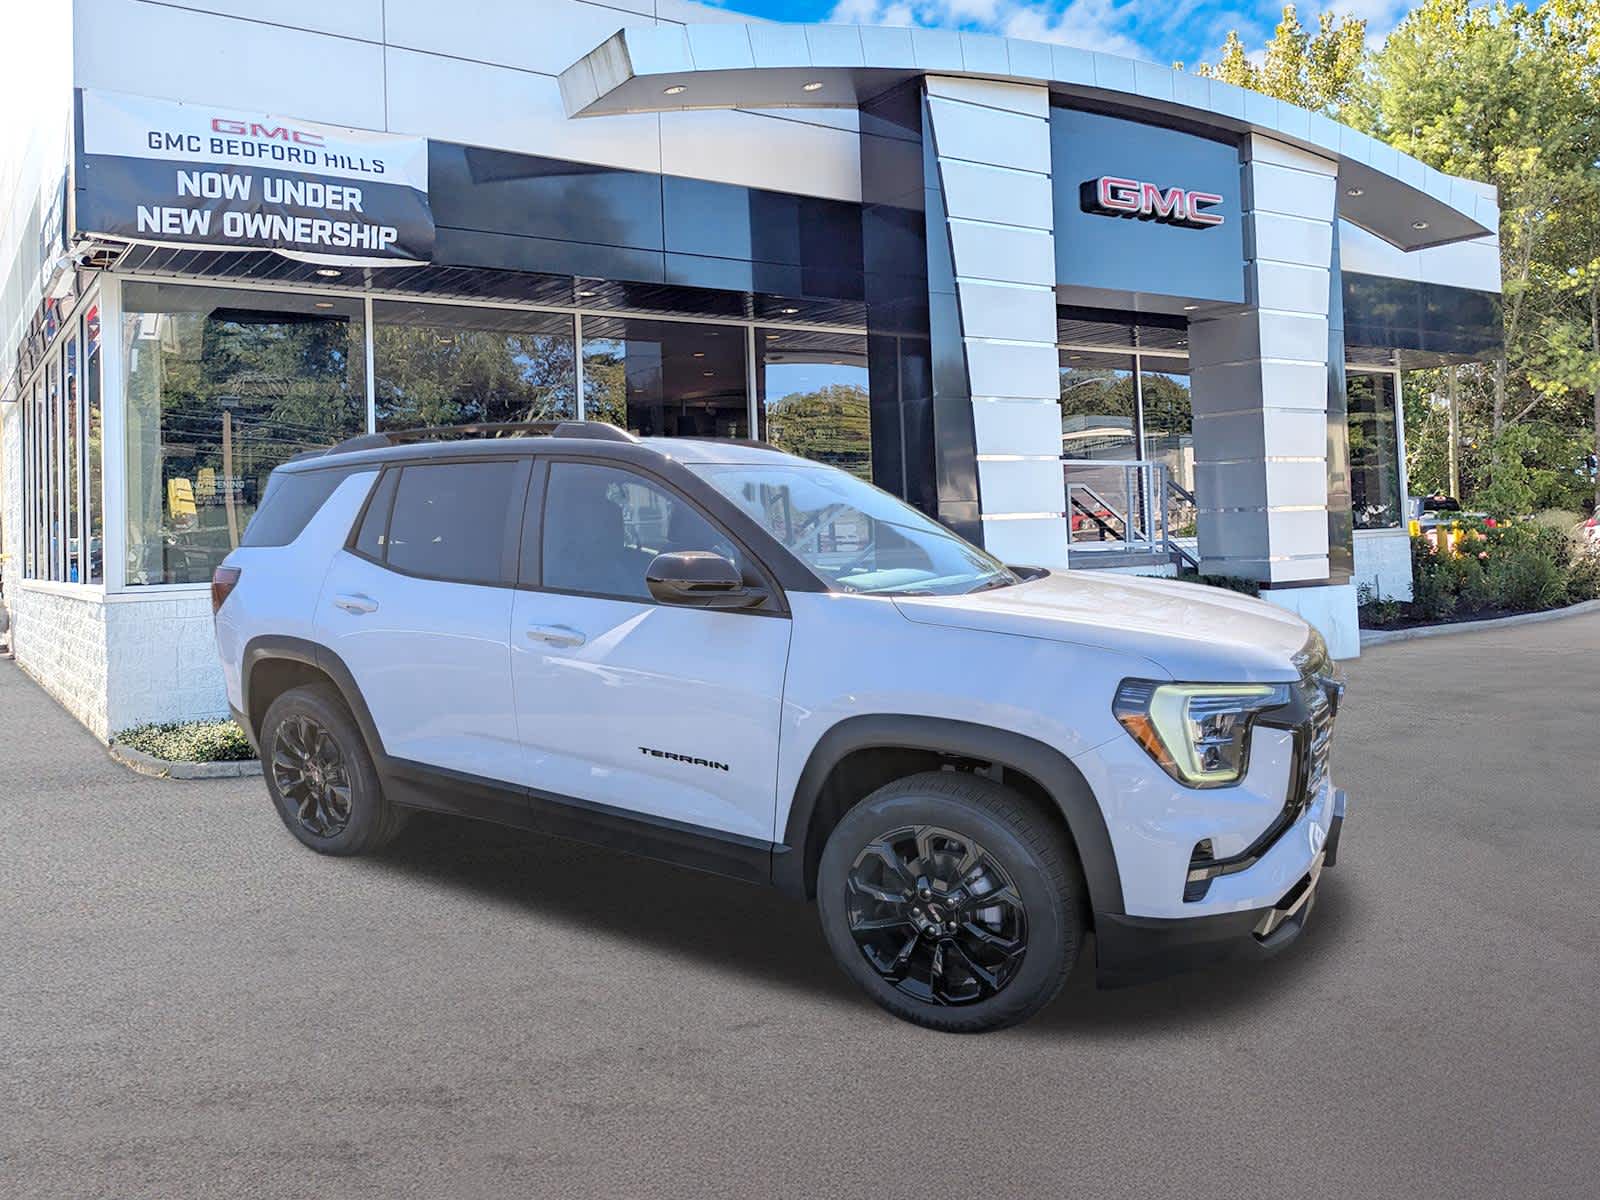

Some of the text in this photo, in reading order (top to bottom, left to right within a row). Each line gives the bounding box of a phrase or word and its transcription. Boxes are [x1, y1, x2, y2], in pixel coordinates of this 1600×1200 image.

[149, 131, 385, 174] GMC BEDFORD HILLS
[211, 118, 326, 147] GMC
[177, 170, 363, 212] NOW UNDER
[1098, 176, 1224, 224] GMC
[137, 206, 398, 250] NEW OWNERSHIP
[638, 746, 729, 771] TERRAIN
